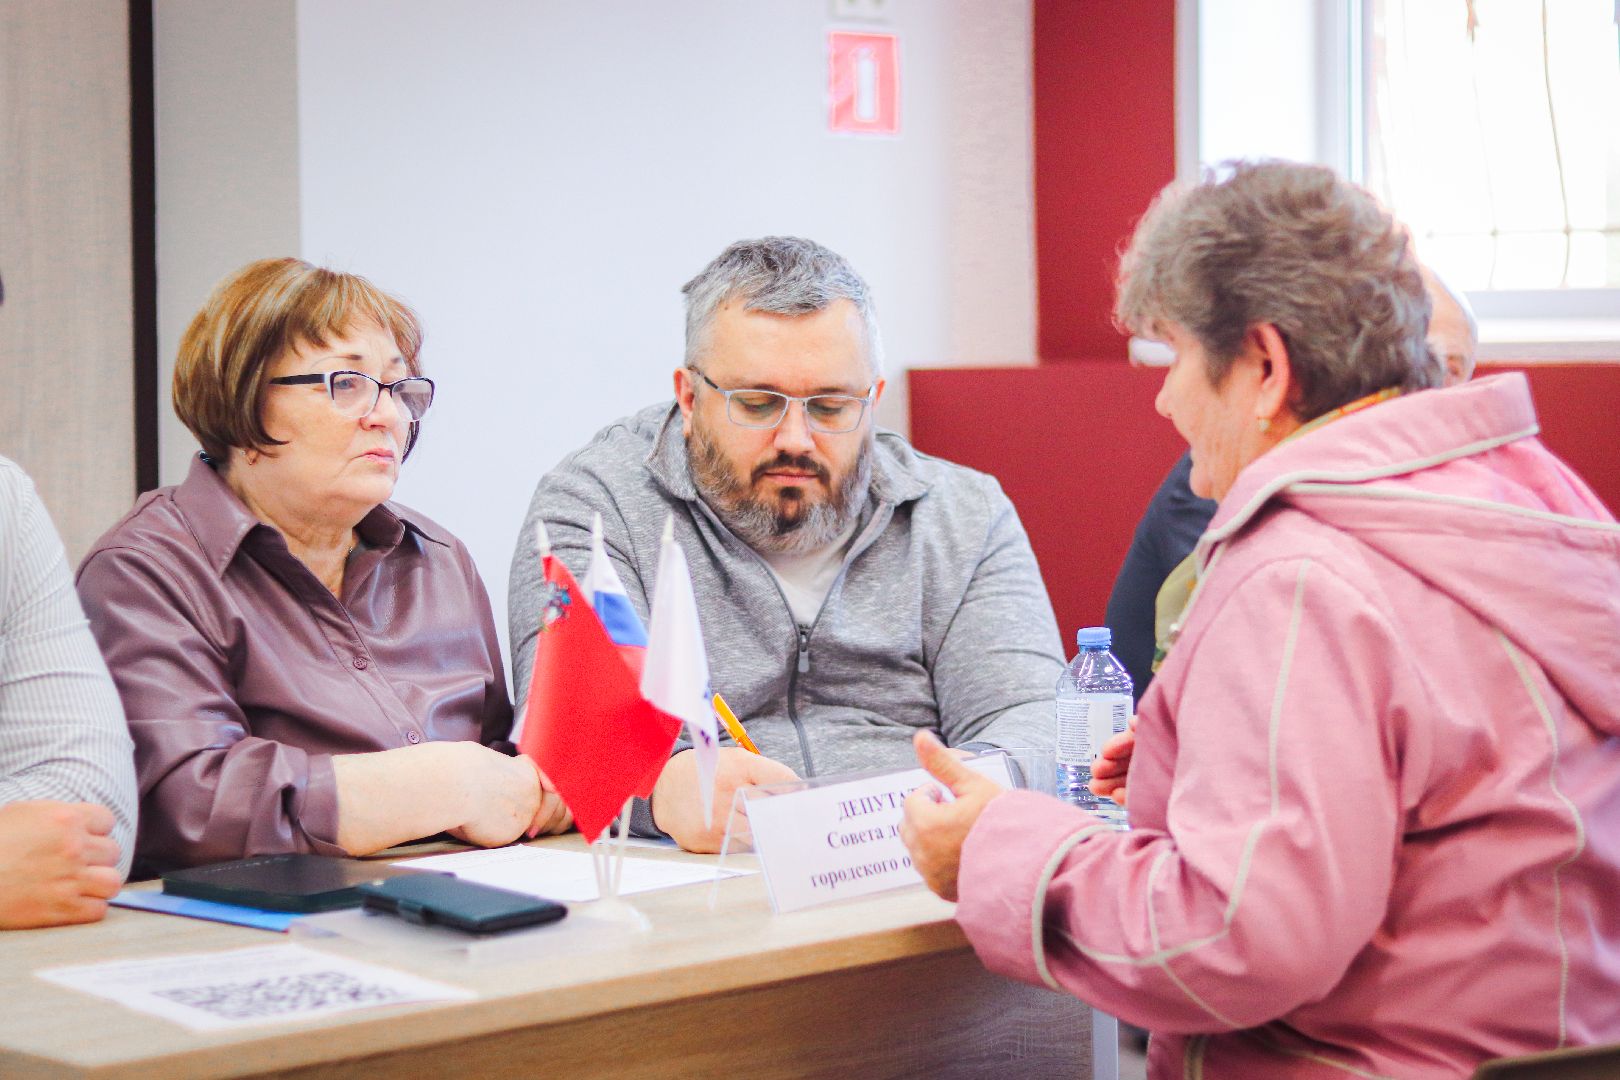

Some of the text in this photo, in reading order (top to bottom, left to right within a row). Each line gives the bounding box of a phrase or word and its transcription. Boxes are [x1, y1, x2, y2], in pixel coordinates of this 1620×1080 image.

[838, 787, 917, 821] ДЕПУТА
[827, 827, 884, 849] Совета
[810, 858, 898, 889] городского
